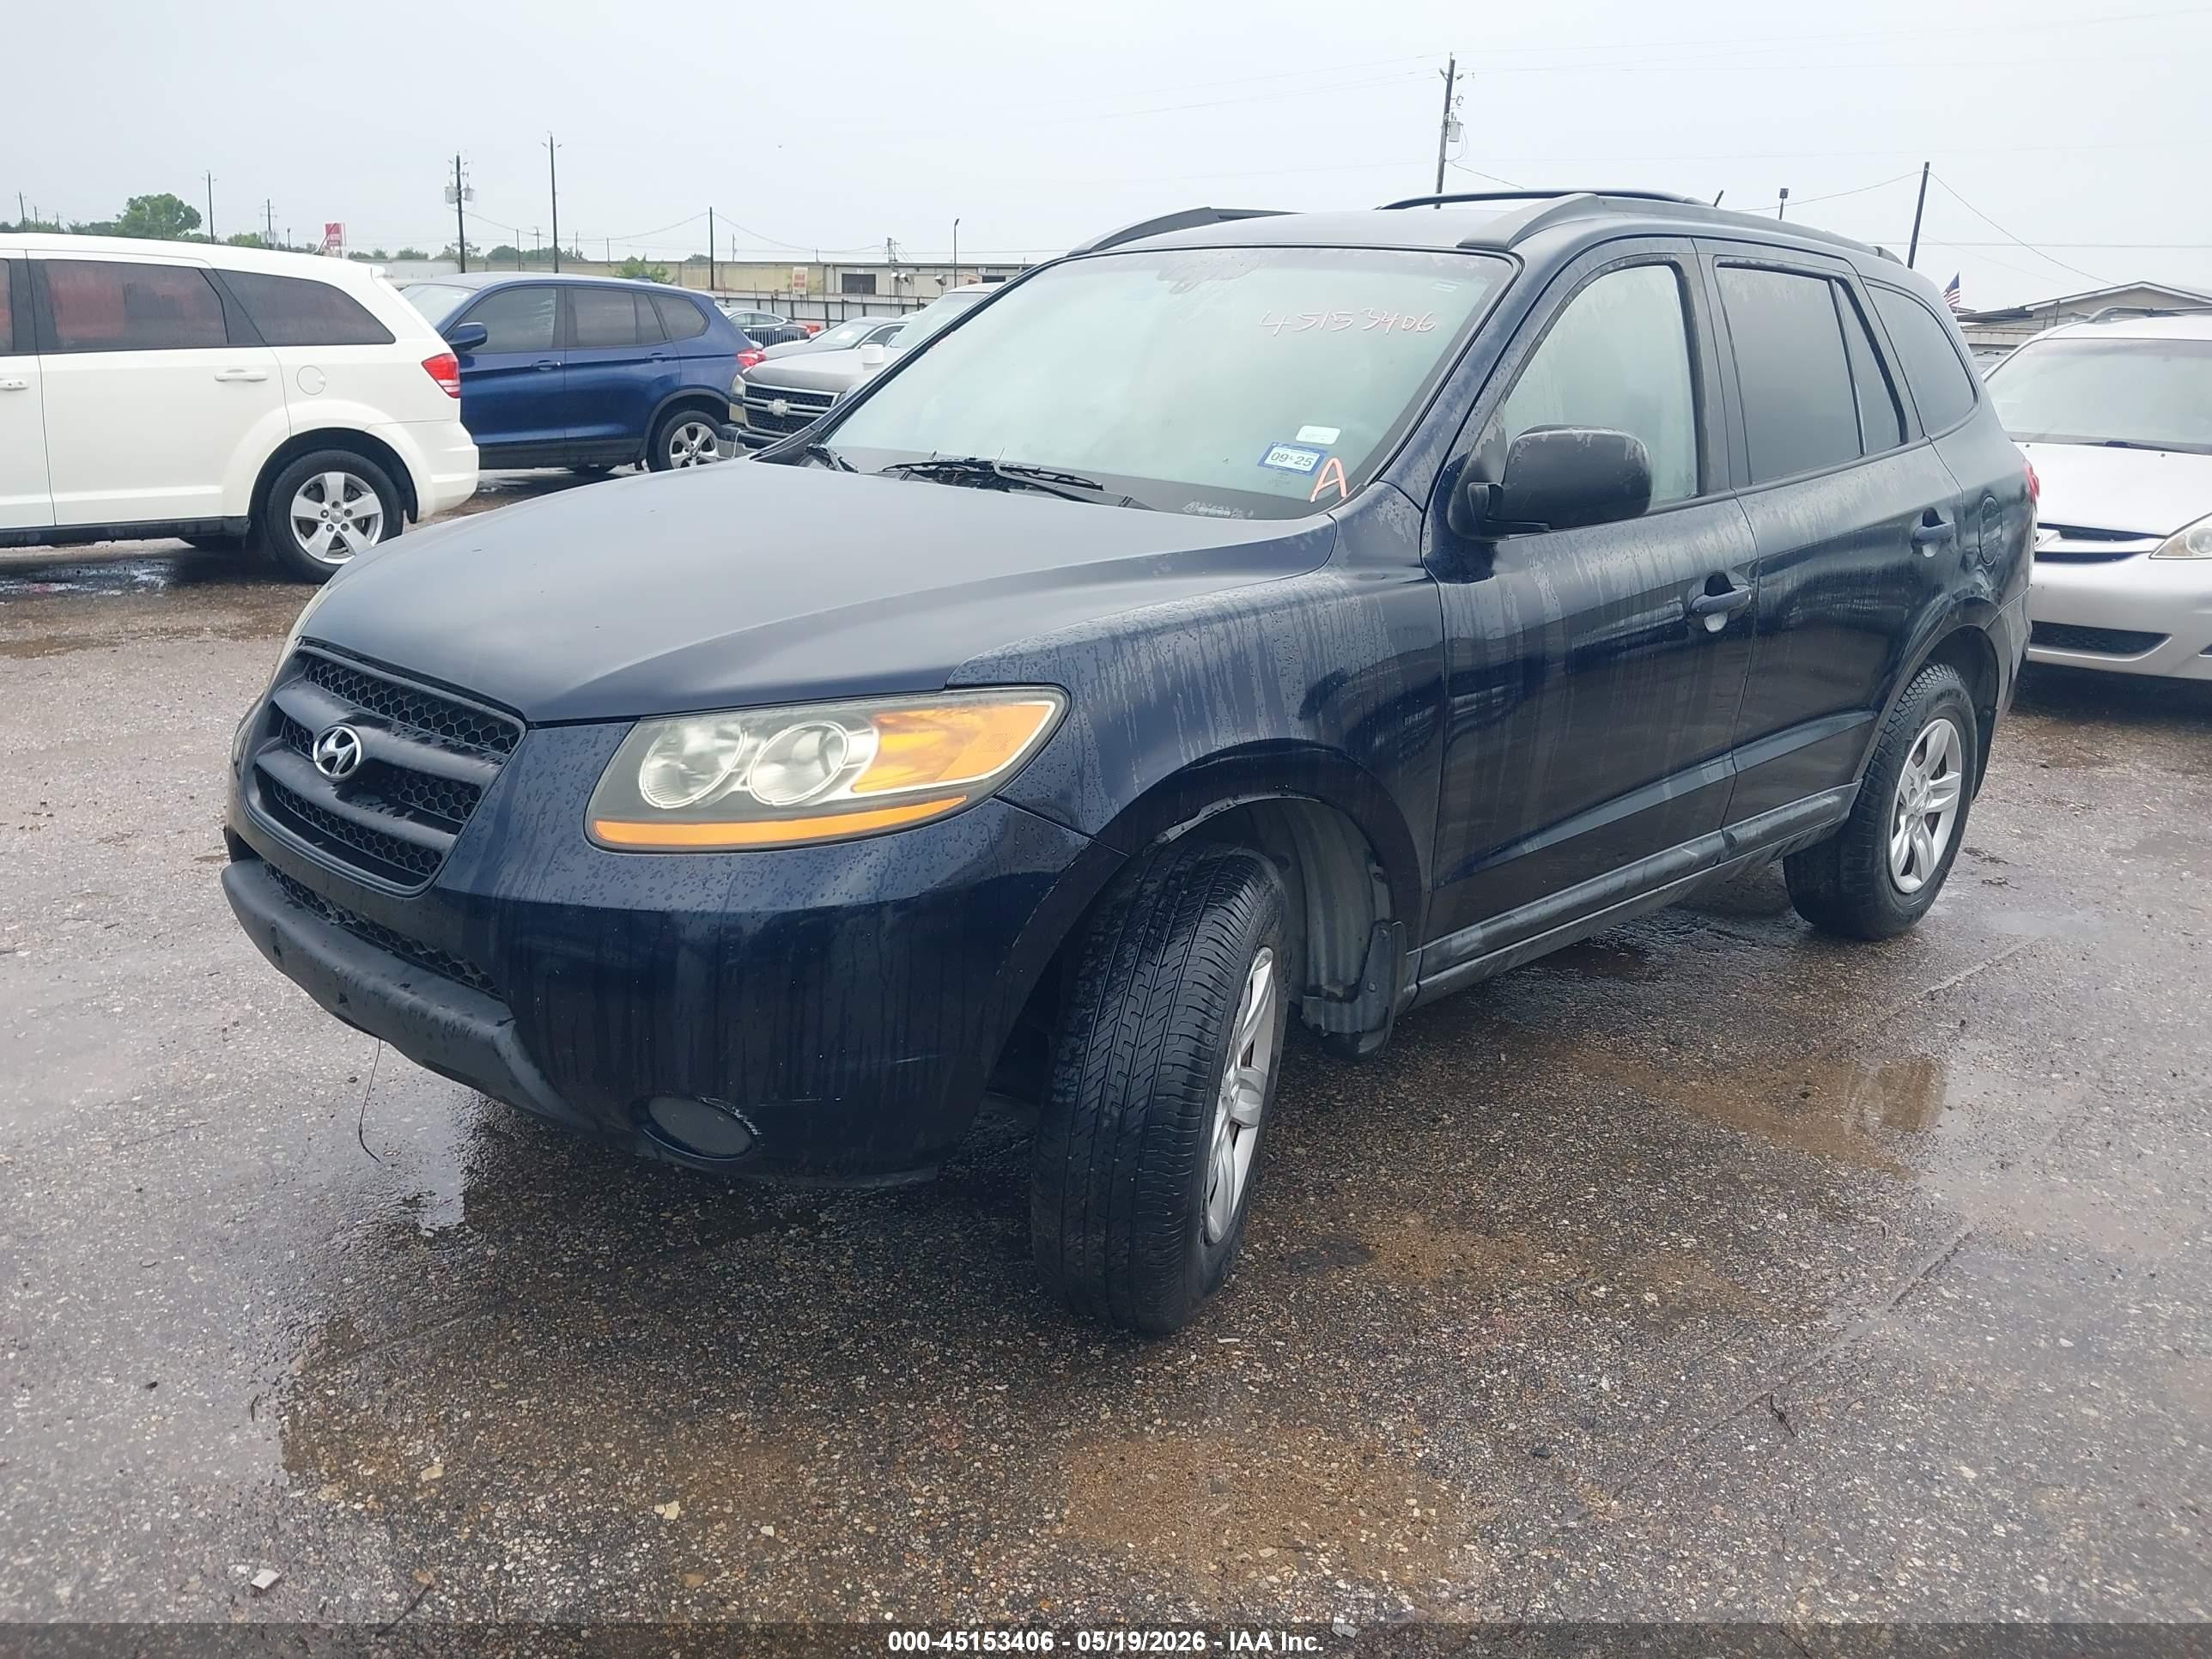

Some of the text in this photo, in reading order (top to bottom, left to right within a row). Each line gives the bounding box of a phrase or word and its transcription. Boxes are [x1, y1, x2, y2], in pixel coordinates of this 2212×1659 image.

[1271, 452, 1314, 467] 09 25
[1310, 458, 1347, 503] A
